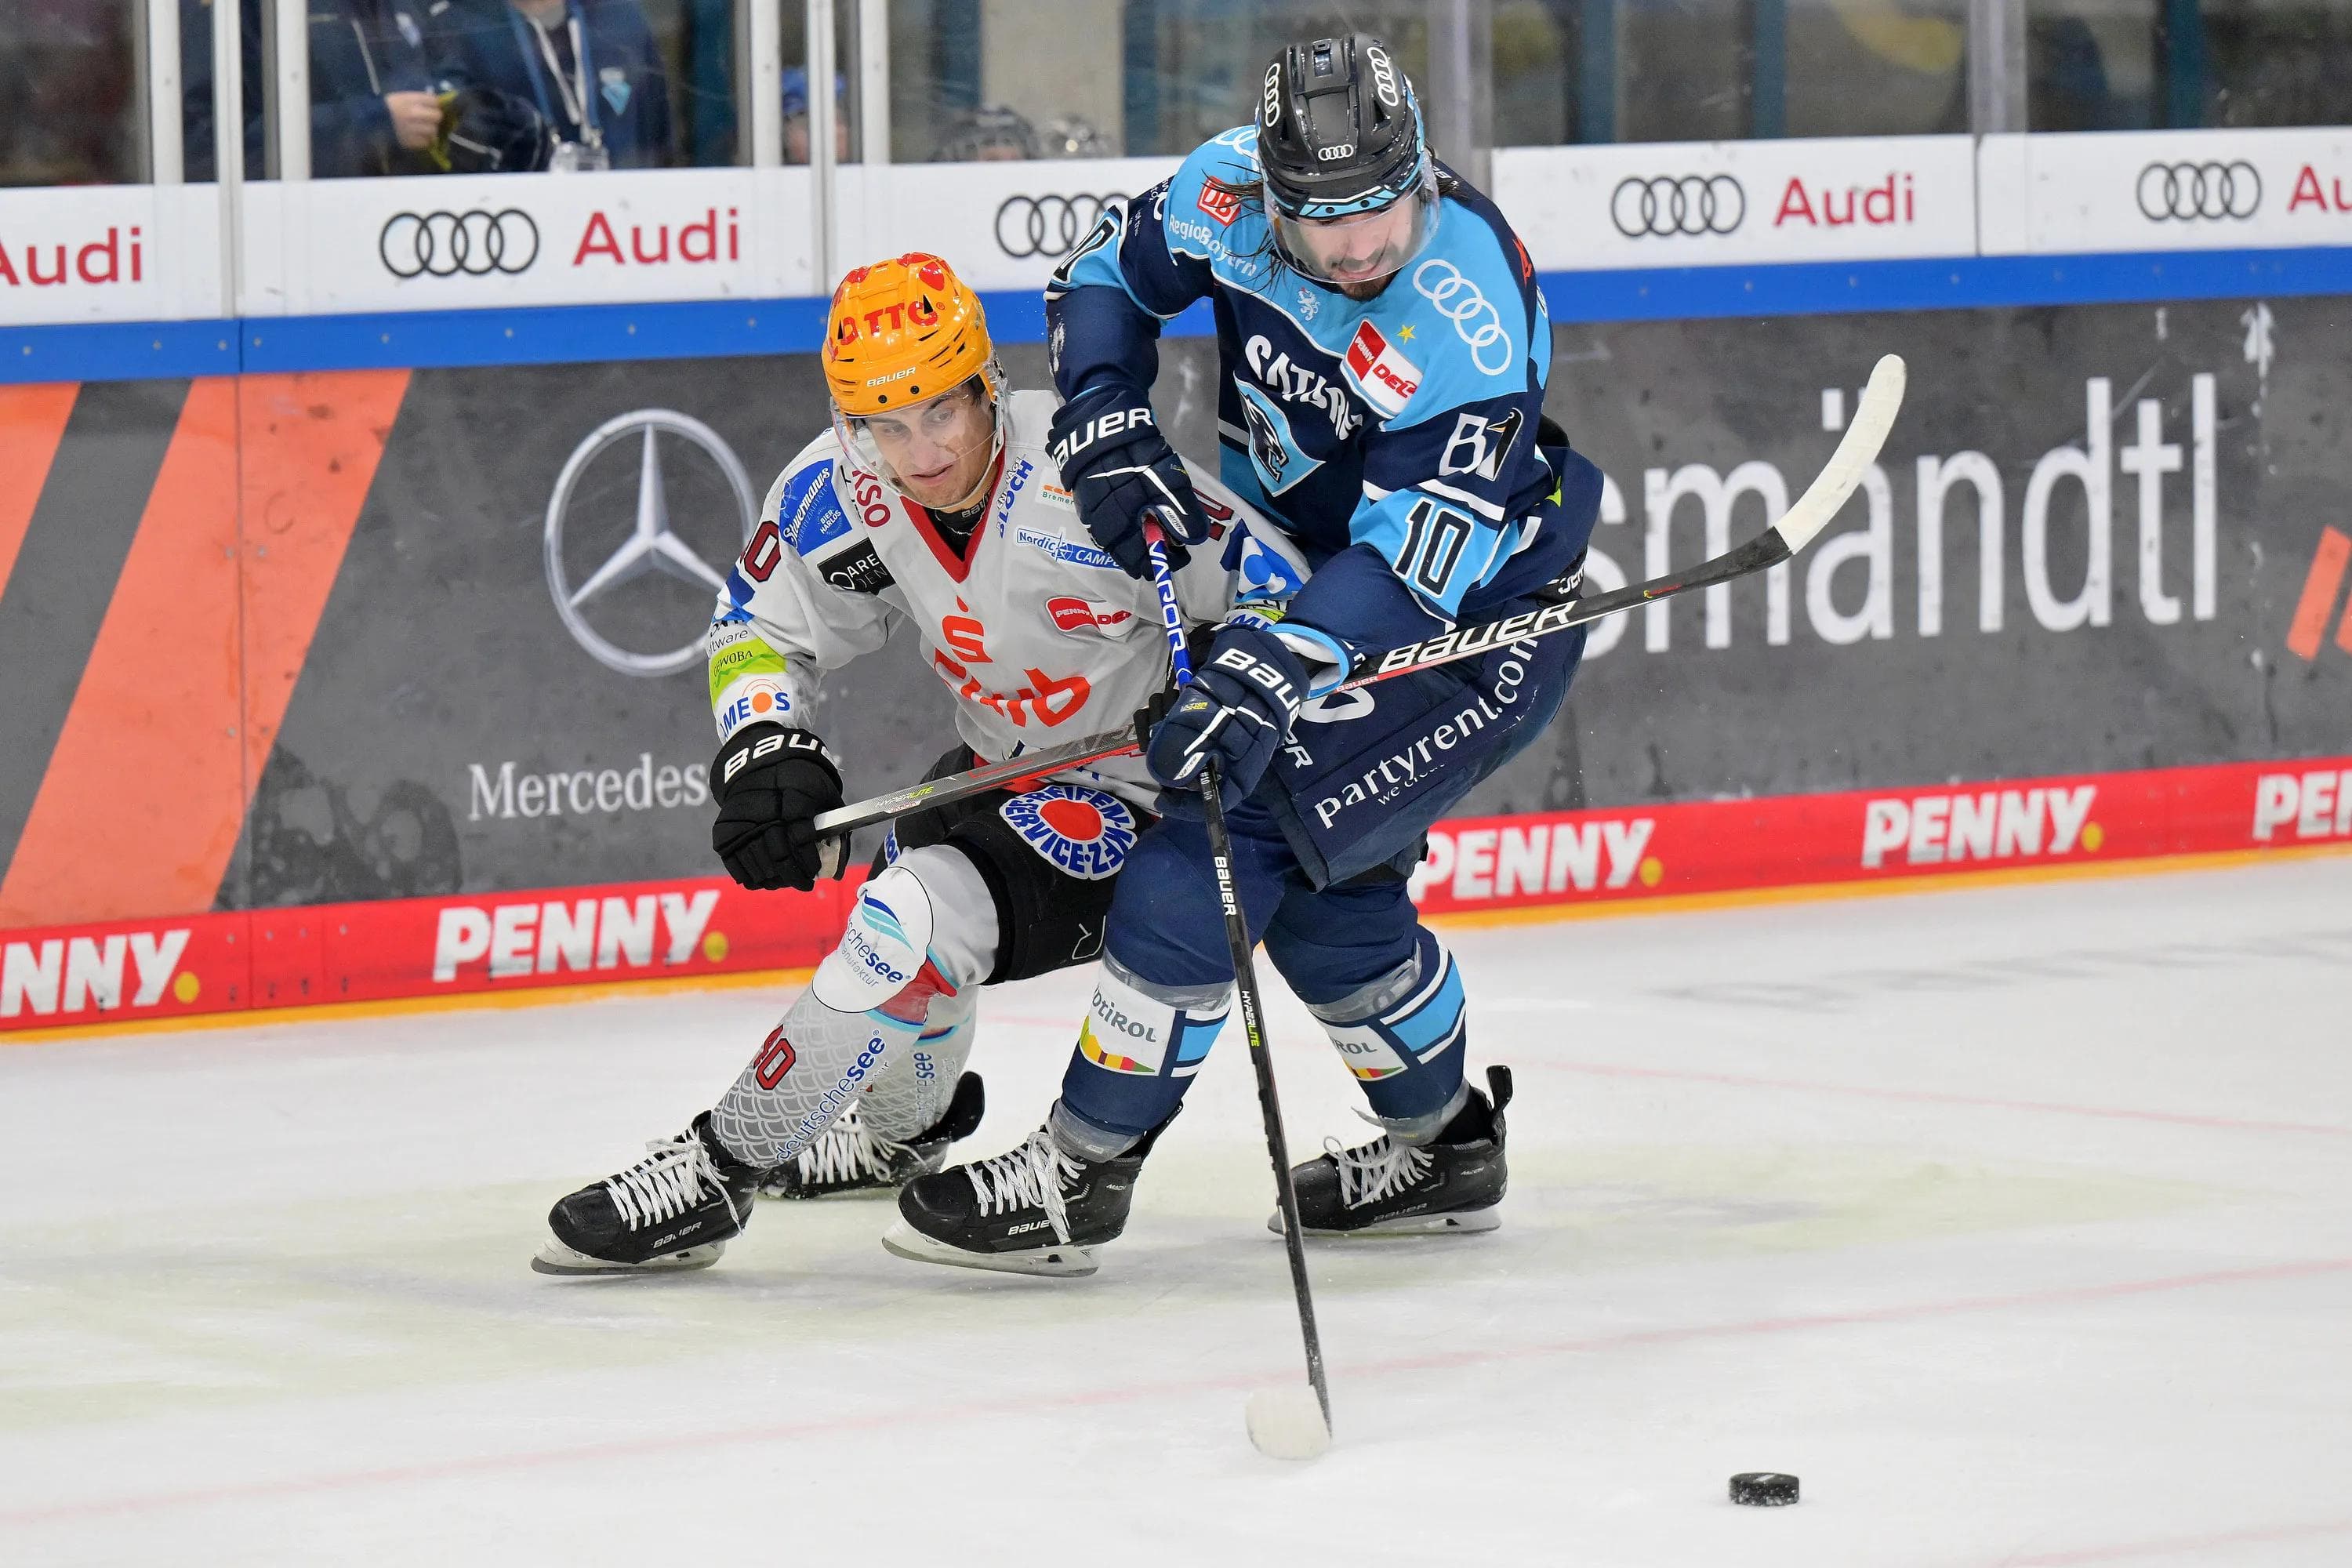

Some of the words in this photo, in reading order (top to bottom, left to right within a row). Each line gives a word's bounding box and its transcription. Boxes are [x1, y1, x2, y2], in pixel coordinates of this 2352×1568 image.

[1773, 173, 1915, 228] Audi
[573, 208, 739, 265] Audi
[839, 300, 938, 346] OTTO
[866, 365, 917, 388] BAUER
[1018, 530, 1058, 553] Nordic
[1392, 496, 1475, 598] 10
[1148, 539, 1186, 662] VAPOR
[714, 649, 753, 678] GEWOBA
[1377, 600, 1578, 675] BAUER
[1336, 674, 1378, 693] BAUER
[468, 753, 710, 822] Mercedes
[1214, 855, 1237, 916] BAUER
[1241, 989, 1261, 1047] HYPERLITE
[775, 1036, 886, 1163] deutschesee
